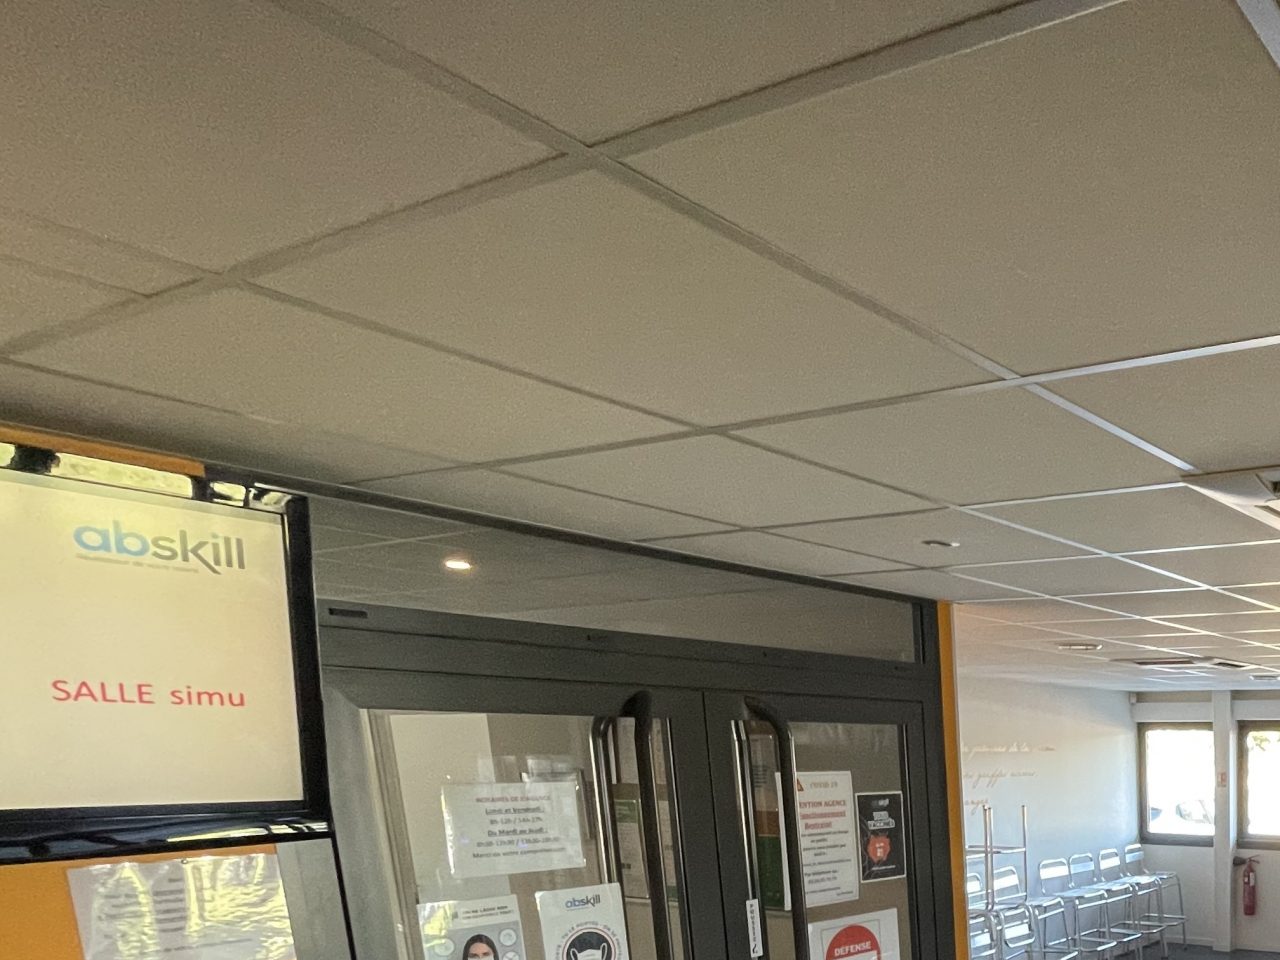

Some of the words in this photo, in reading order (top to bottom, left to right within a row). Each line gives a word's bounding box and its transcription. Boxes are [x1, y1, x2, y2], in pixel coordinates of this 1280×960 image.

[73, 520, 246, 575] abskill
[52, 679, 155, 705] SALLE
[170, 685, 246, 707] simu
[565, 894, 601, 908] abskill
[834, 941, 871, 957] DEFENSE
